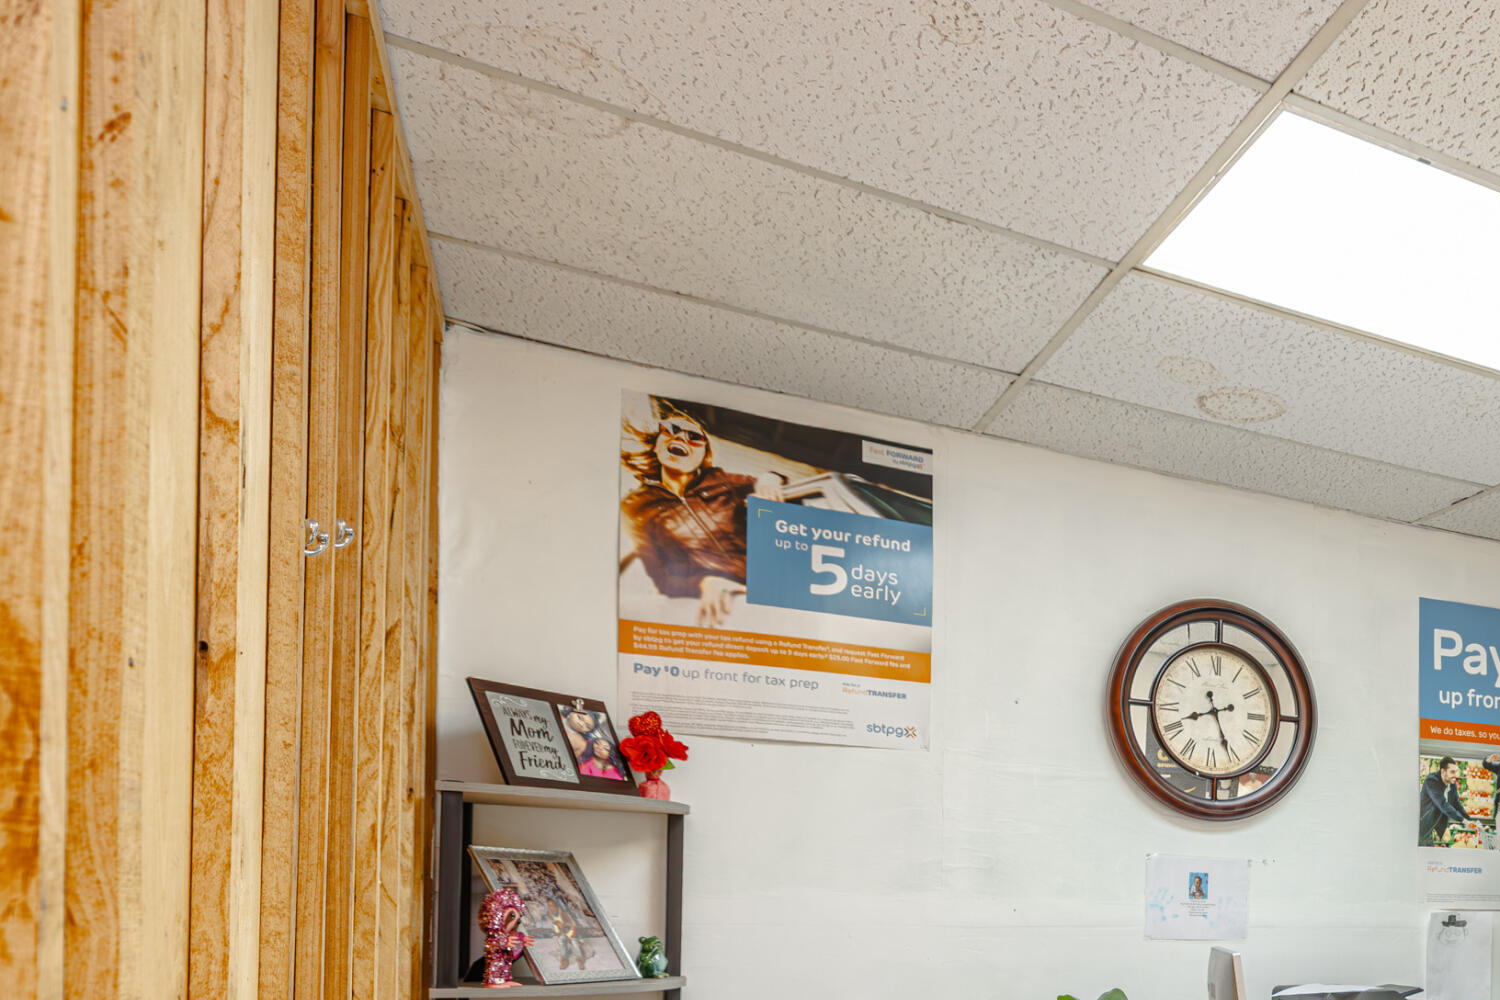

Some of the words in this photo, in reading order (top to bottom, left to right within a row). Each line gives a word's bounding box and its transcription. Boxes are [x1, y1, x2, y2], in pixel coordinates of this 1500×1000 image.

[775, 519, 808, 537] Get
[811, 527, 852, 543] your
[855, 534, 911, 552] refund
[775, 538, 791, 550] up
[795, 540, 809, 551] to
[809, 544, 849, 596] 5
[851, 564, 898, 586] days
[851, 584, 901, 605] early
[633, 662, 661, 677] Pay
[664, 665, 680, 677] $0
[682, 669, 700, 680] up
[704, 668, 738, 682] front
[742, 672, 762, 684] for
[765, 675, 786, 687] tax
[790, 678, 819, 690] prep
[1439, 689, 1463, 709] up
[510, 718, 553, 742] Mom
[1430, 725, 1442, 735] We
[1443, 726, 1453, 735] do
[1478, 730, 1488, 738] so
[1488, 731, 1500, 741] you
[519, 751, 566, 770] Friend
